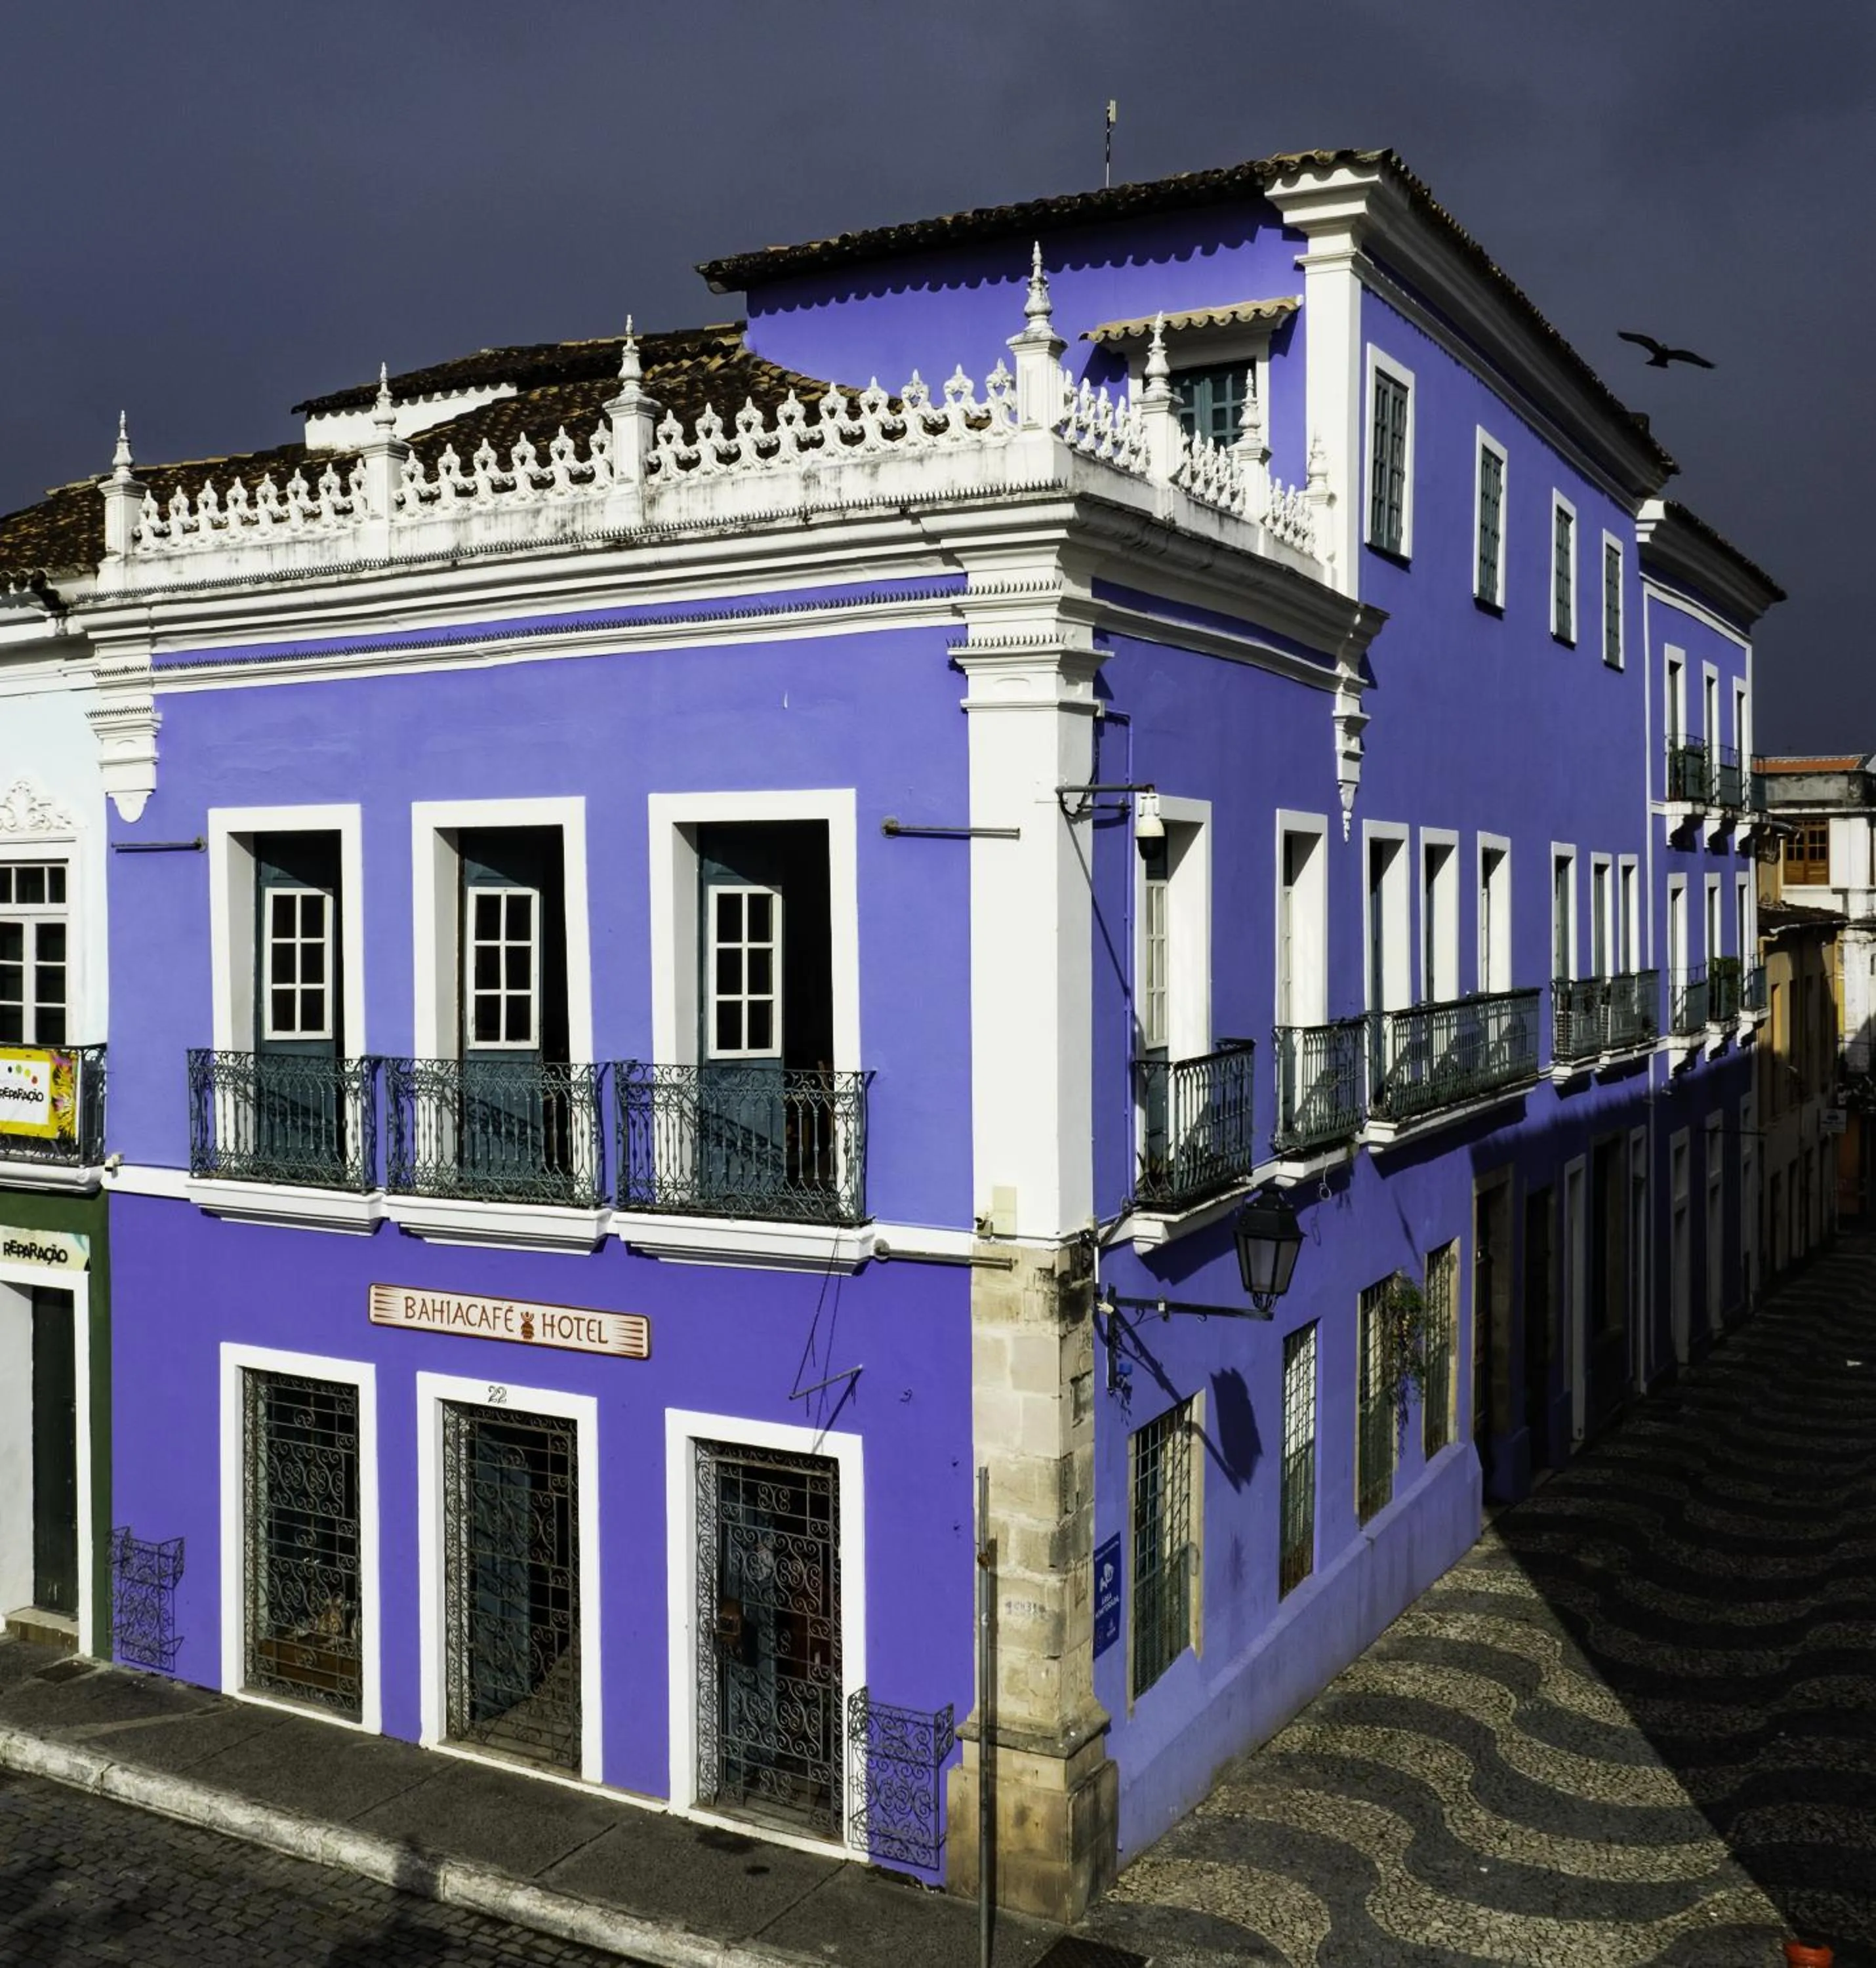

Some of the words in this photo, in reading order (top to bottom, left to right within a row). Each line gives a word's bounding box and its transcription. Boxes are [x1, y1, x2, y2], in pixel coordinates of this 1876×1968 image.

[3, 1240, 68, 1265] REPARAÇÃO
[404, 1296, 515, 1332] BAHIACAFÉ
[542, 1314, 609, 1344] HOTEL
[487, 1385, 507, 1404] 22
